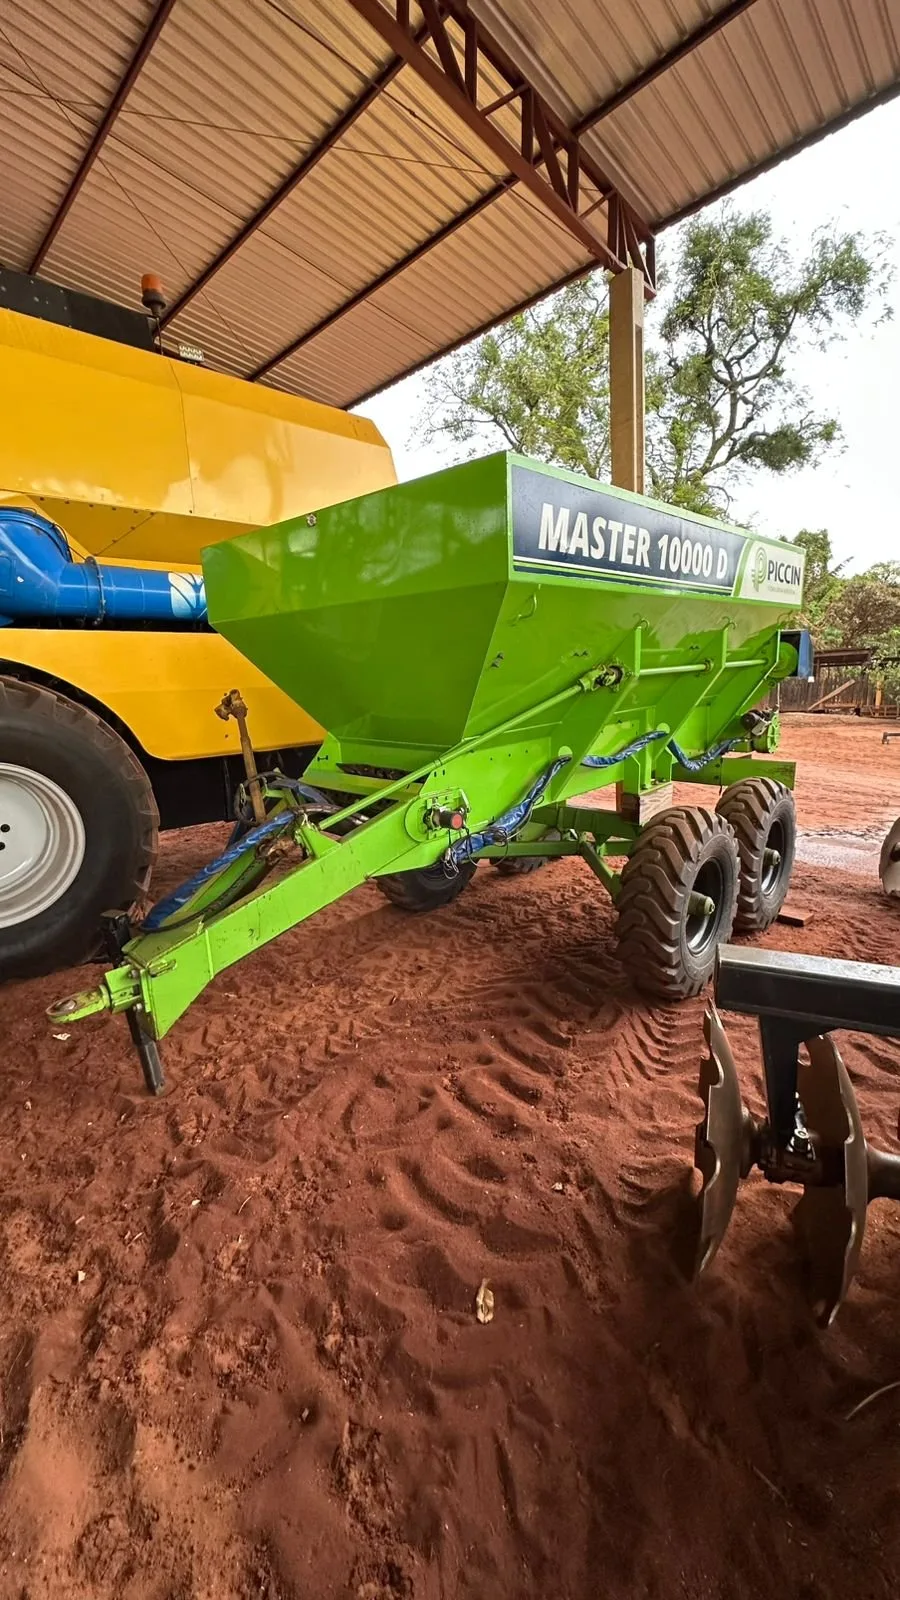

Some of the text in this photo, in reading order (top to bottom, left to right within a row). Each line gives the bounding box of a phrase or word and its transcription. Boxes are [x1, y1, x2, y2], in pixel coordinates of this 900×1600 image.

[538, 503, 728, 580] MASTER 10000 D
[767, 560, 801, 586] PICCIN
